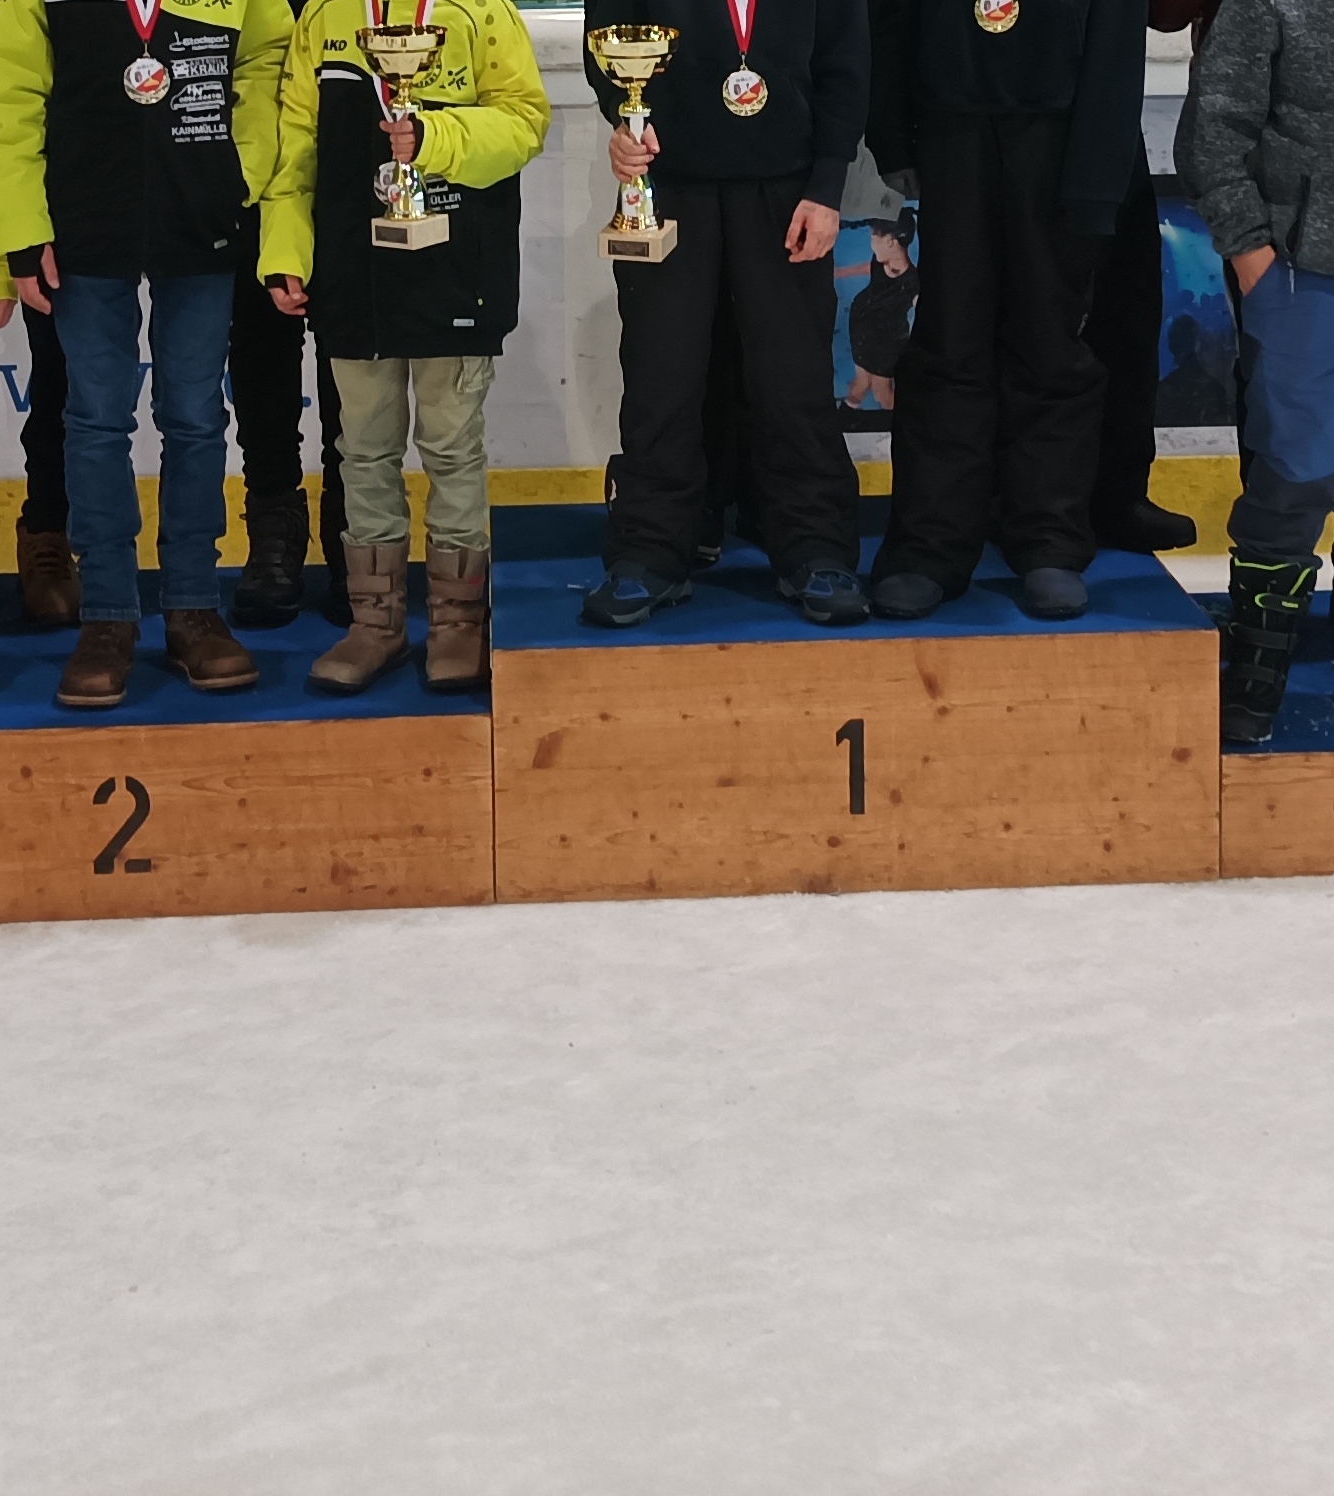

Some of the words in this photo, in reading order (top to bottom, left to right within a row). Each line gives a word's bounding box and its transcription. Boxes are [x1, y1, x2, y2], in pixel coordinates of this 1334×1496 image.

[323, 39, 347, 51] AKO
[836, 718, 865, 815] 1
[93, 775, 152, 874] 2
